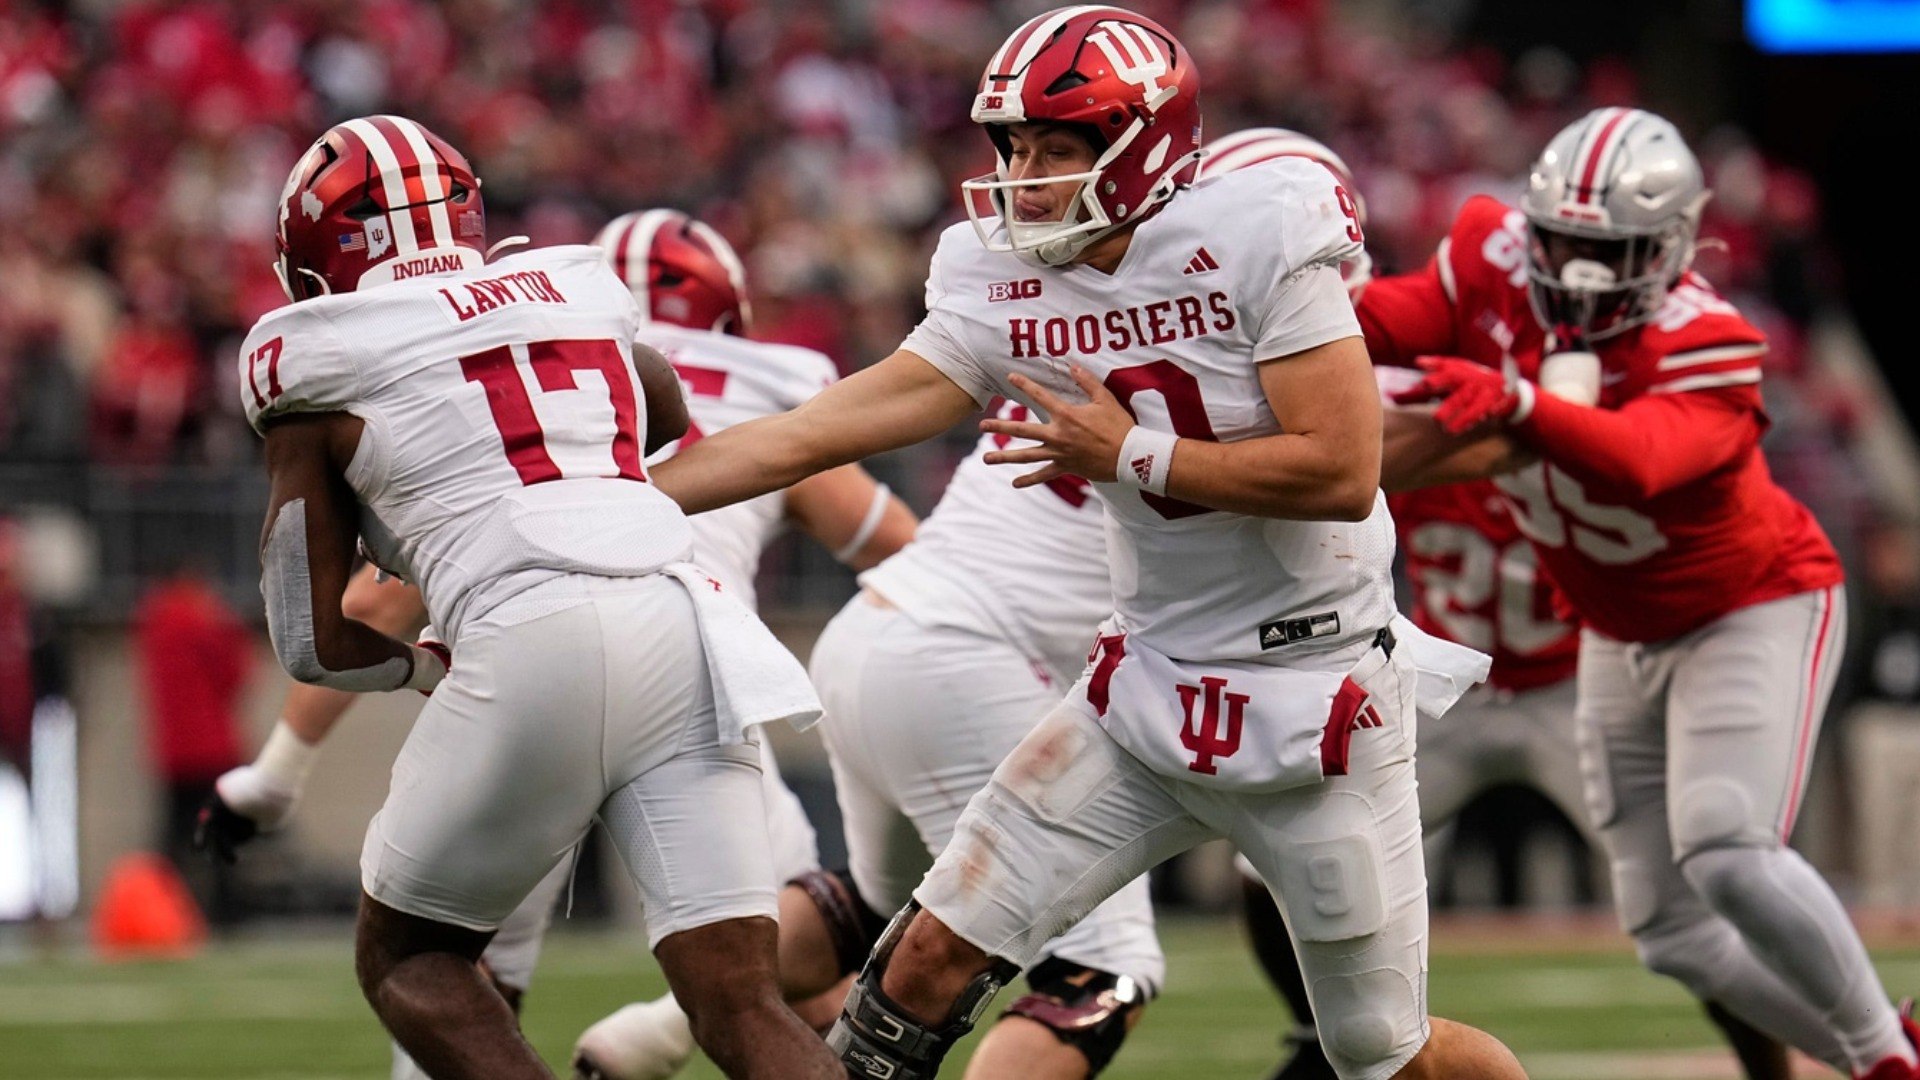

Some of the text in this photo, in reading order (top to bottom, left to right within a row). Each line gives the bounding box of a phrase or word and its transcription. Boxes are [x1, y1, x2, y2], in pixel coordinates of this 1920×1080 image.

[392, 254, 464, 281] INDIANA
[438, 270, 567, 321] LAWTON
[1009, 291, 1236, 358] HOOSIERS
[249, 336, 283, 410] 17
[458, 338, 647, 486] 17
[1307, 854, 1353, 916] 9
